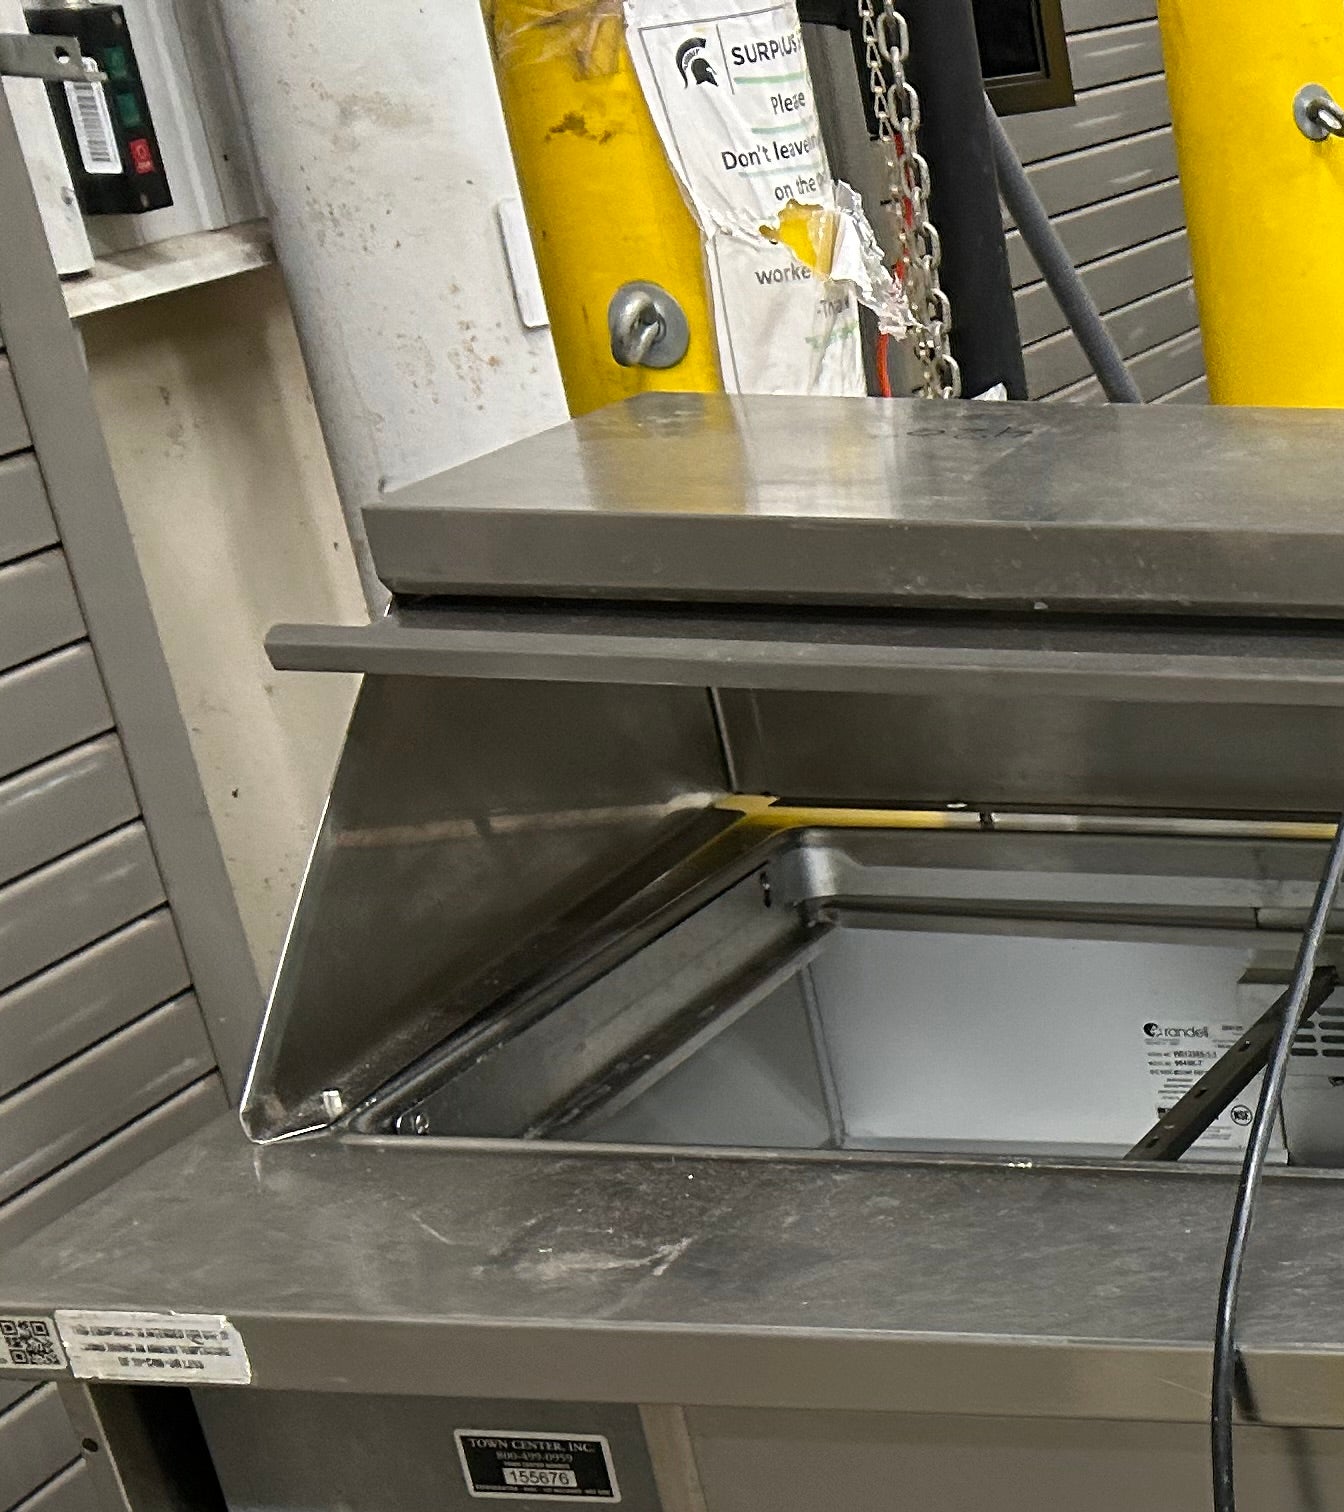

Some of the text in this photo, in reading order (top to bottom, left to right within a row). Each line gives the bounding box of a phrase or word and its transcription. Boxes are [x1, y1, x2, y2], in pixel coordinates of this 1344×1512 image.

[731, 34, 798, 66] SURPLUS
[721, 144, 771, 170] Don't
[772, 141, 810, 161] leave
[774, 184, 794, 201] on
[796, 176, 817, 195] the
[469, 1438, 508, 1449] TOWN
